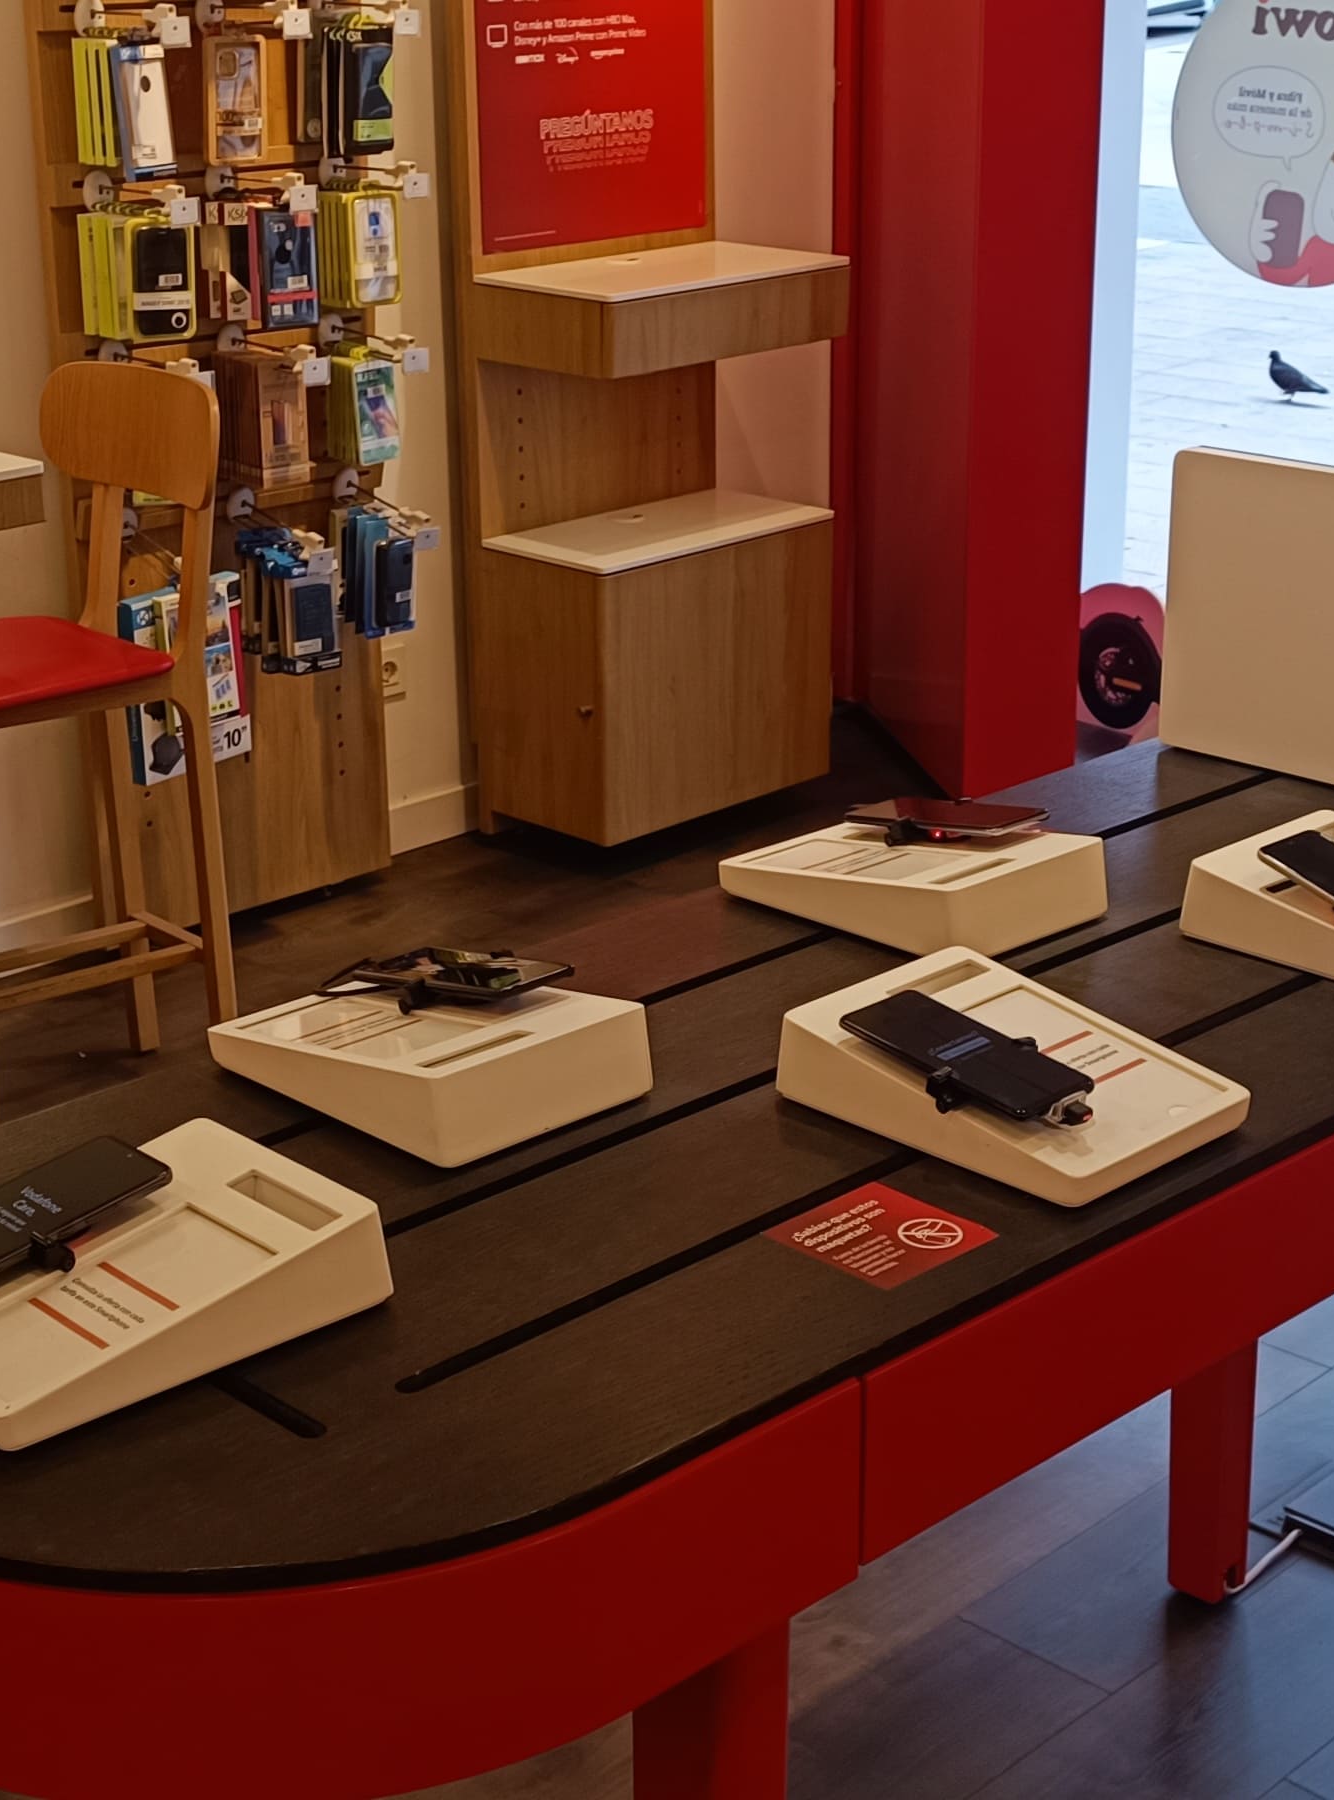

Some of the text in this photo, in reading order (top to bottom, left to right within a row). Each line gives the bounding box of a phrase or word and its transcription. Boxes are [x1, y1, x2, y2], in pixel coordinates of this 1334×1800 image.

[539, 109, 654, 140] PREGÚNTANOS
[804, 1208, 886, 1246] dispositivos son
[816, 1224, 873, 1253] maquetas?
